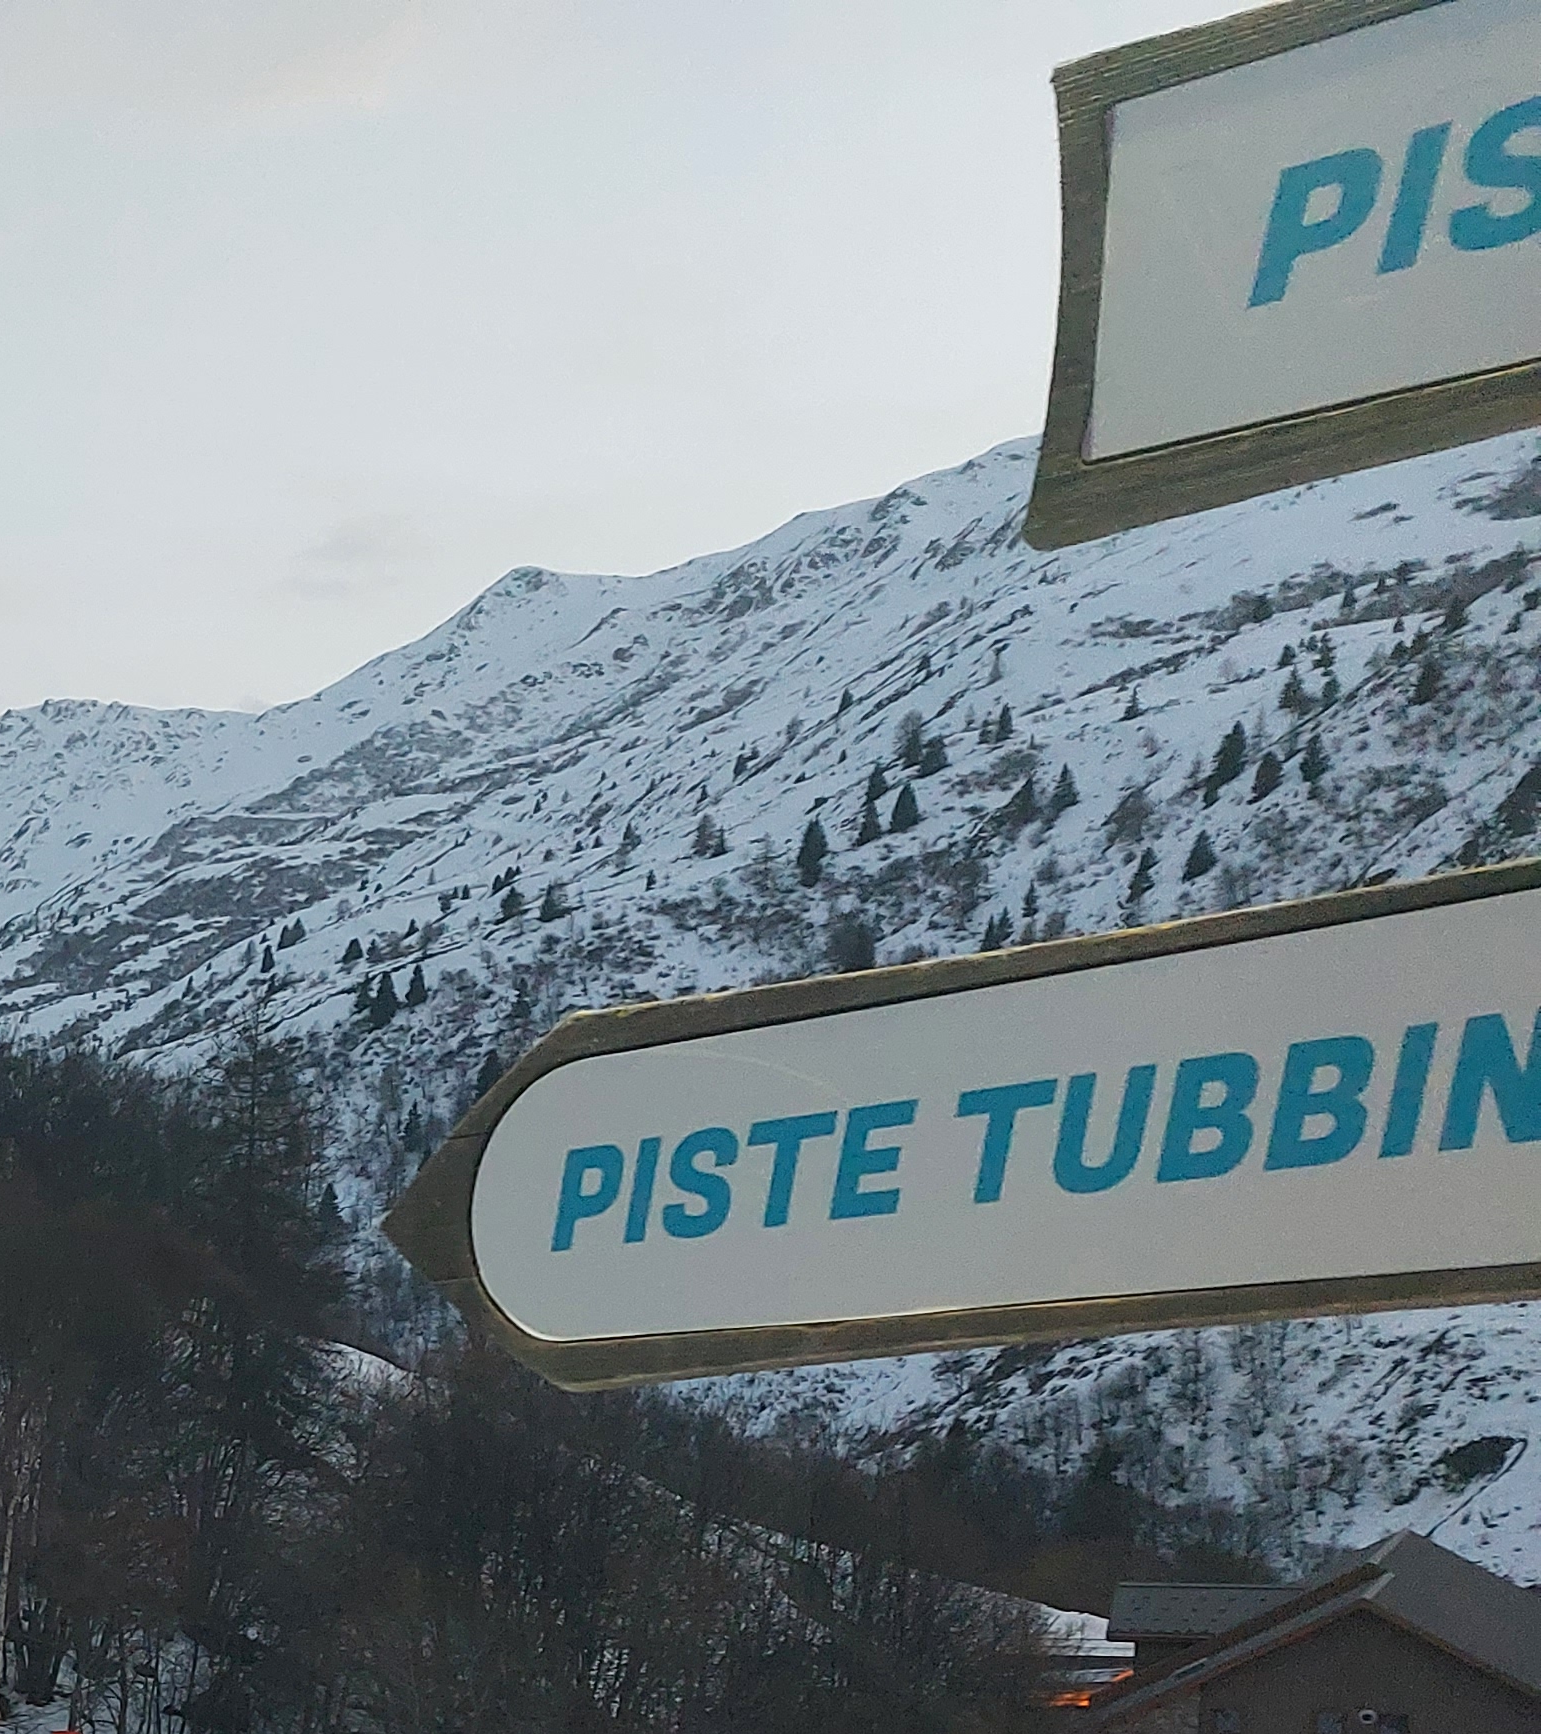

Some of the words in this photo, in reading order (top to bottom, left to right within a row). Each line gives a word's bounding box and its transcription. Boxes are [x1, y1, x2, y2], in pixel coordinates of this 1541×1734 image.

[1246, 94, 1541, 310] PIS
[550, 1098, 919, 1253] PISTE
[954, 1010, 1541, 1205] TUBBIN
